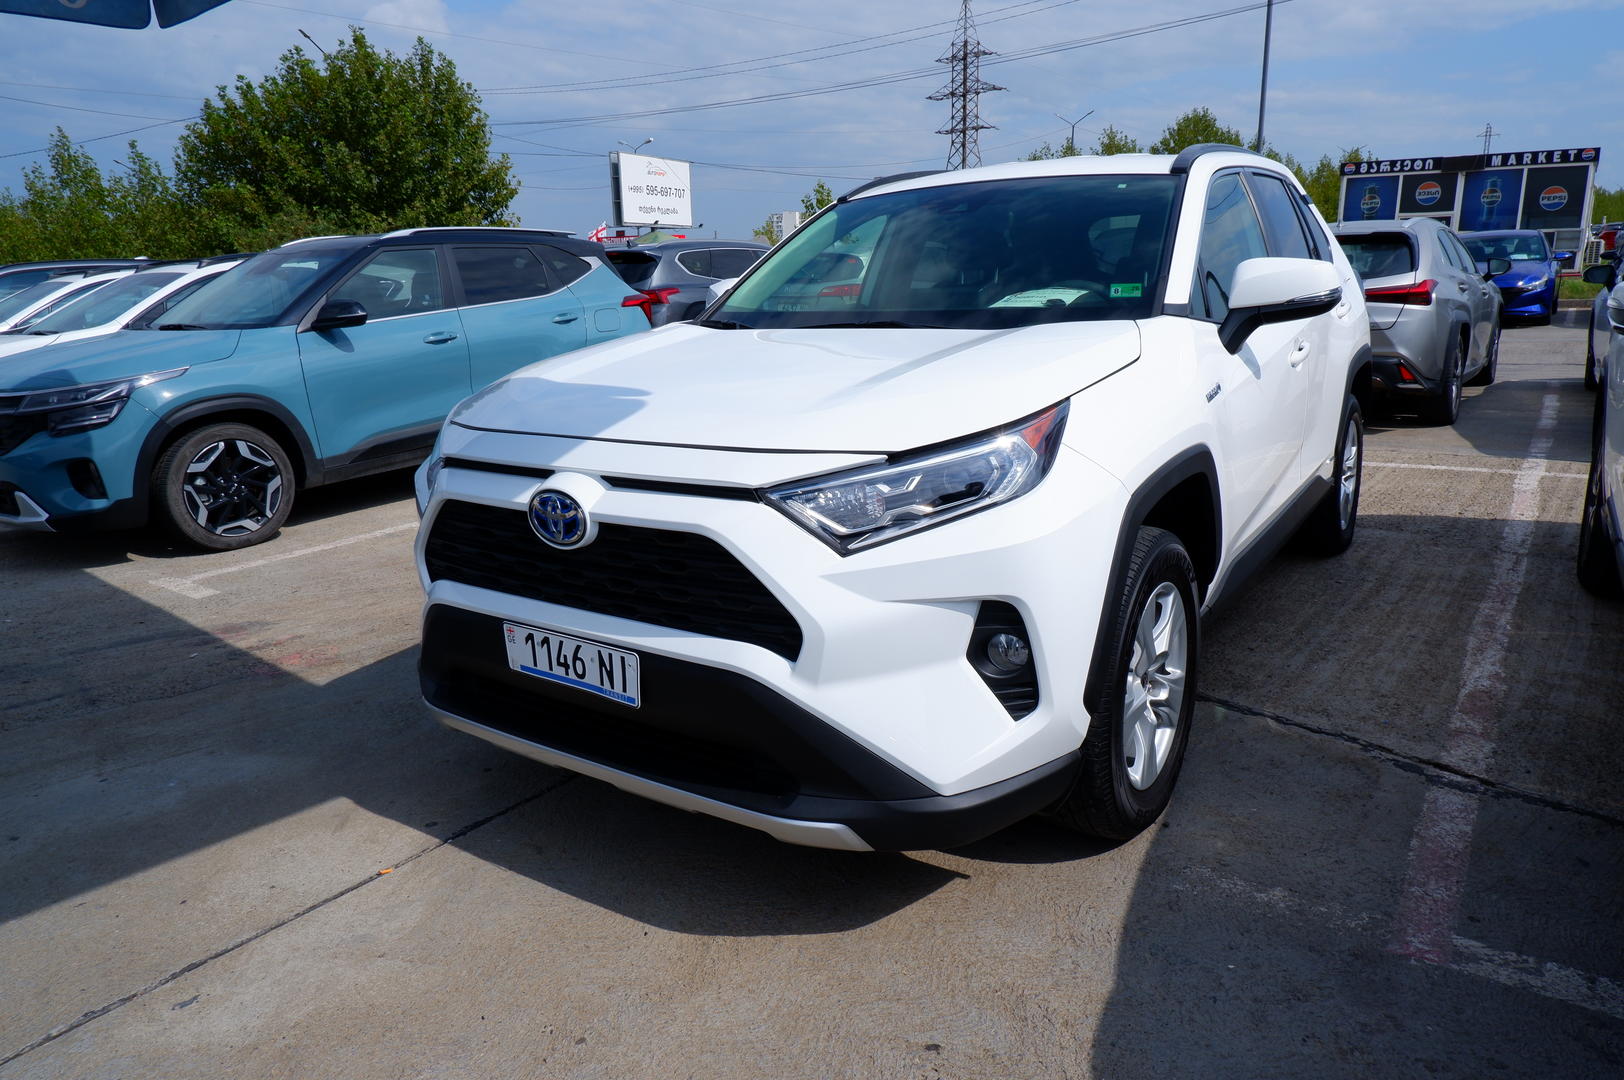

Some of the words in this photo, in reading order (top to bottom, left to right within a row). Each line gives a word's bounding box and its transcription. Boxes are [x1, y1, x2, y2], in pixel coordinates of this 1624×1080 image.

[1360, 158, 1434, 173] მარკეტი
[1491, 150, 1577, 166] MARKET
[646, 185, 685, 198] 595-697-707
[525, 632, 587, 680] 1146
[597, 649, 627, 693] NI
